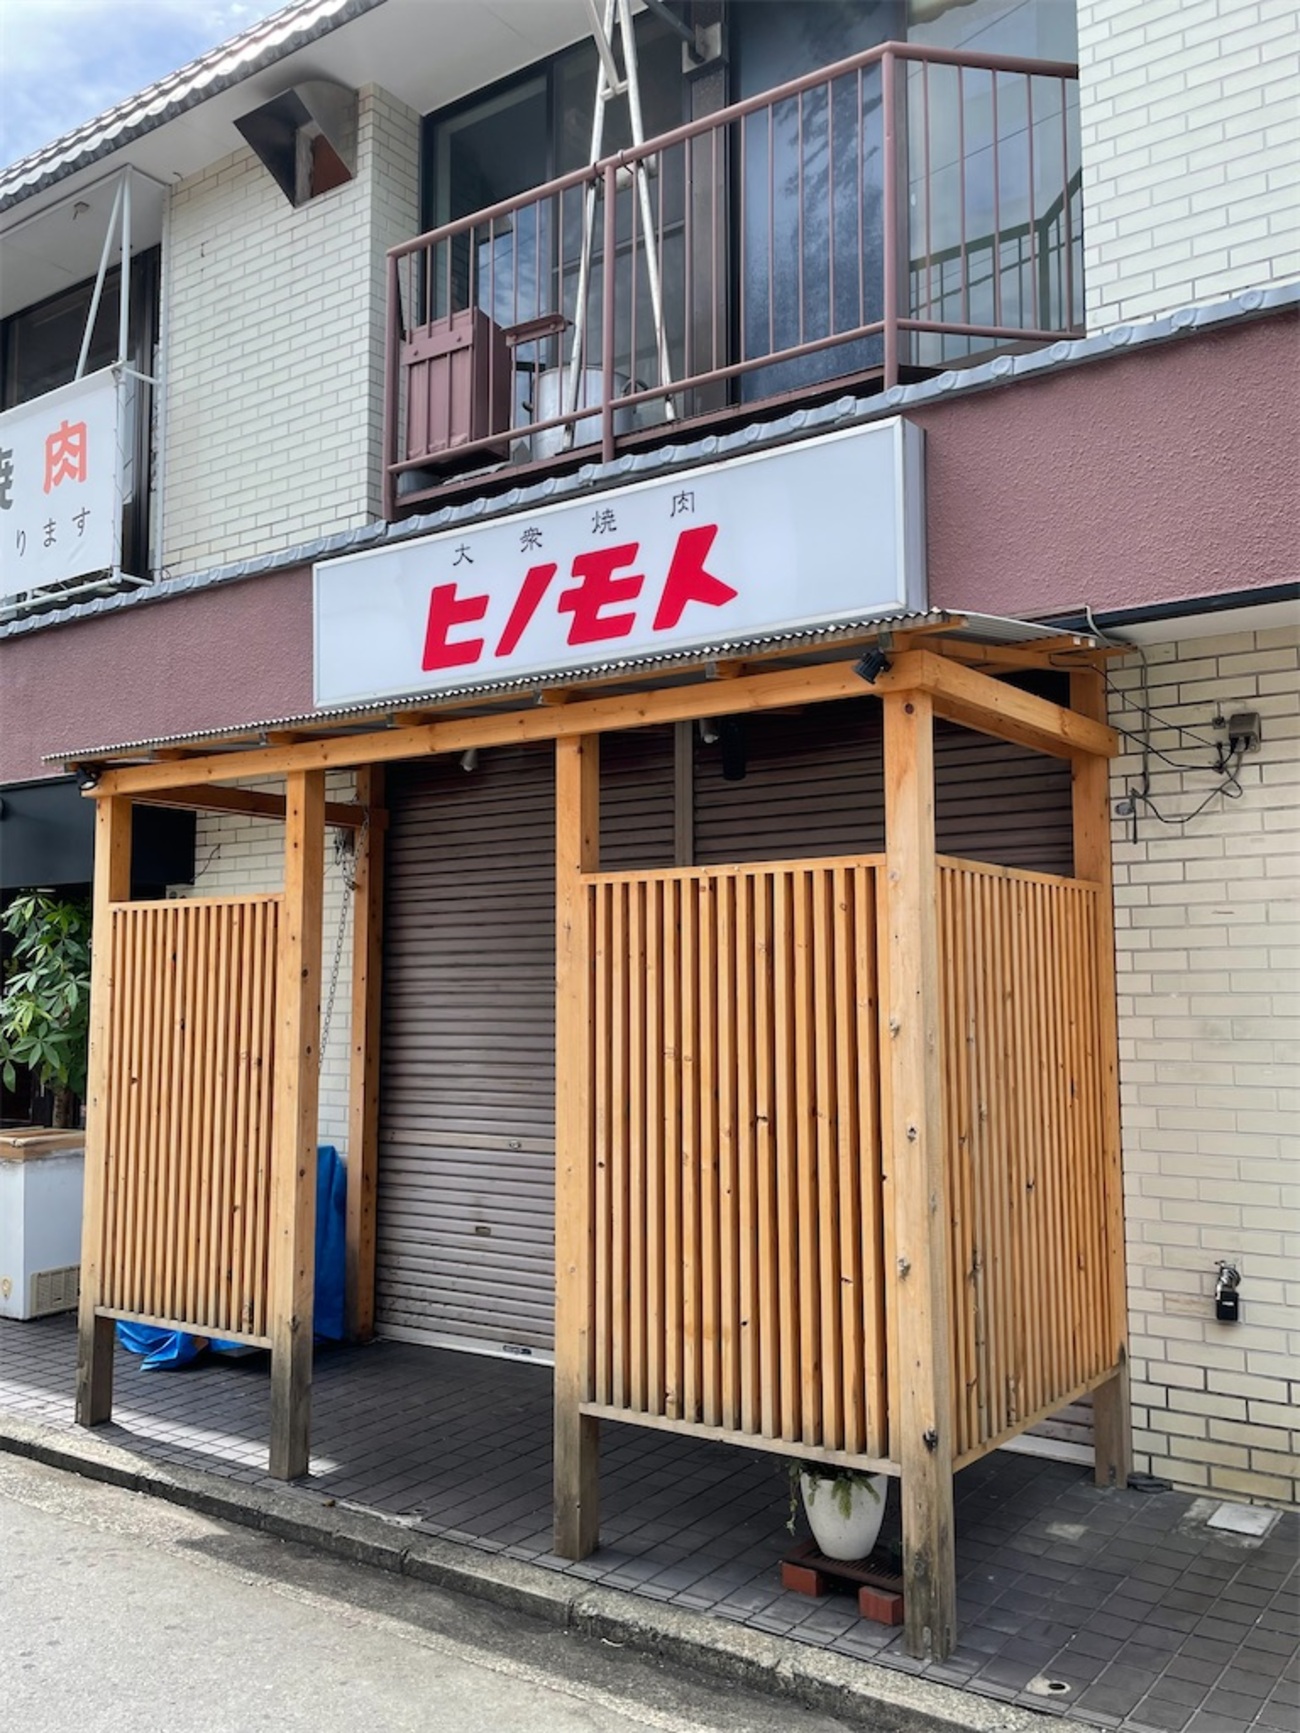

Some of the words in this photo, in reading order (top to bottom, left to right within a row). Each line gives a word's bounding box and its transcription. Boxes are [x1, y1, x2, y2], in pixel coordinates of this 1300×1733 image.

[452, 490, 696, 567] 大衆焼肉
[422, 523, 738, 671] ヒノモト
